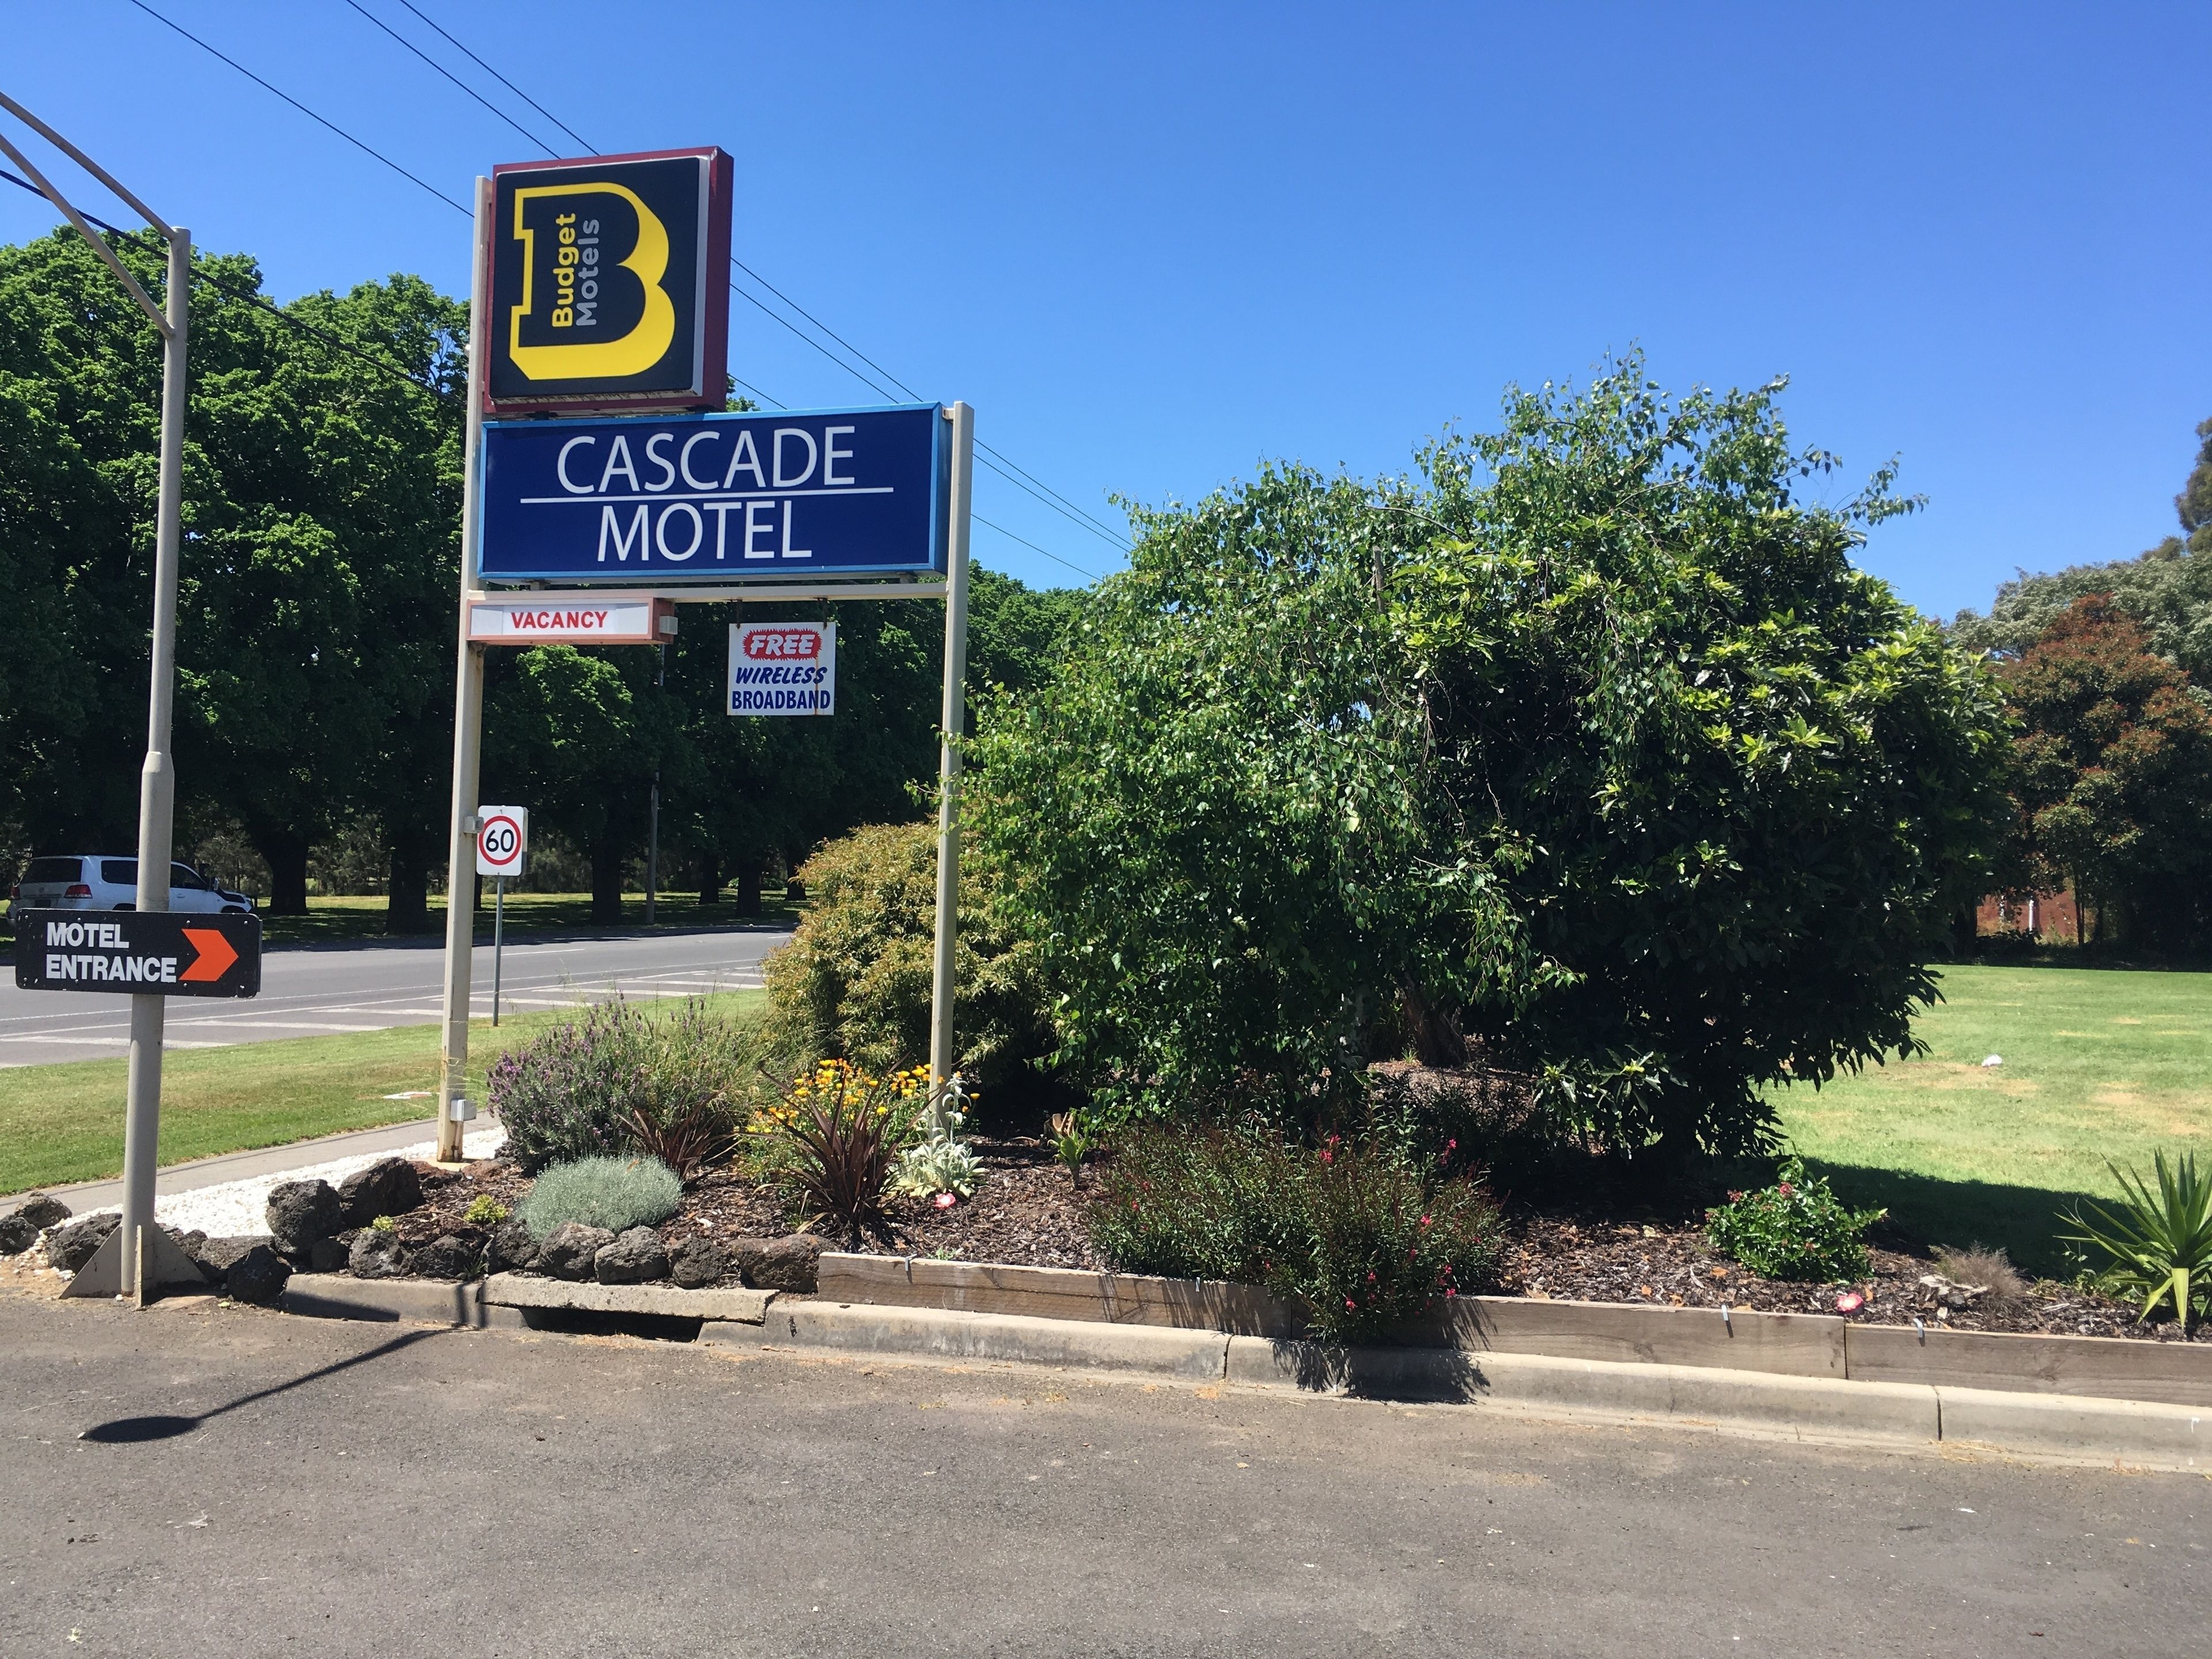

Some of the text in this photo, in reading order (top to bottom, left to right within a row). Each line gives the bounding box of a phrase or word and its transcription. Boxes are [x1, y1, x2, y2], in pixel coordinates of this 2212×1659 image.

[552, 213, 578, 327] Budget
[577, 218, 600, 326] Motels
[557, 426, 855, 493] CASCADE
[597, 500, 812, 562] MOTEL
[511, 611, 608, 628] VACANCY
[749, 634, 816, 655] FREE
[736, 666, 827, 684] WIRELESS
[732, 691, 830, 709] BROADBAND
[486, 829, 514, 853] 60
[47, 922, 130, 948] MOTEL
[46, 954, 177, 982] ENTRANCE
